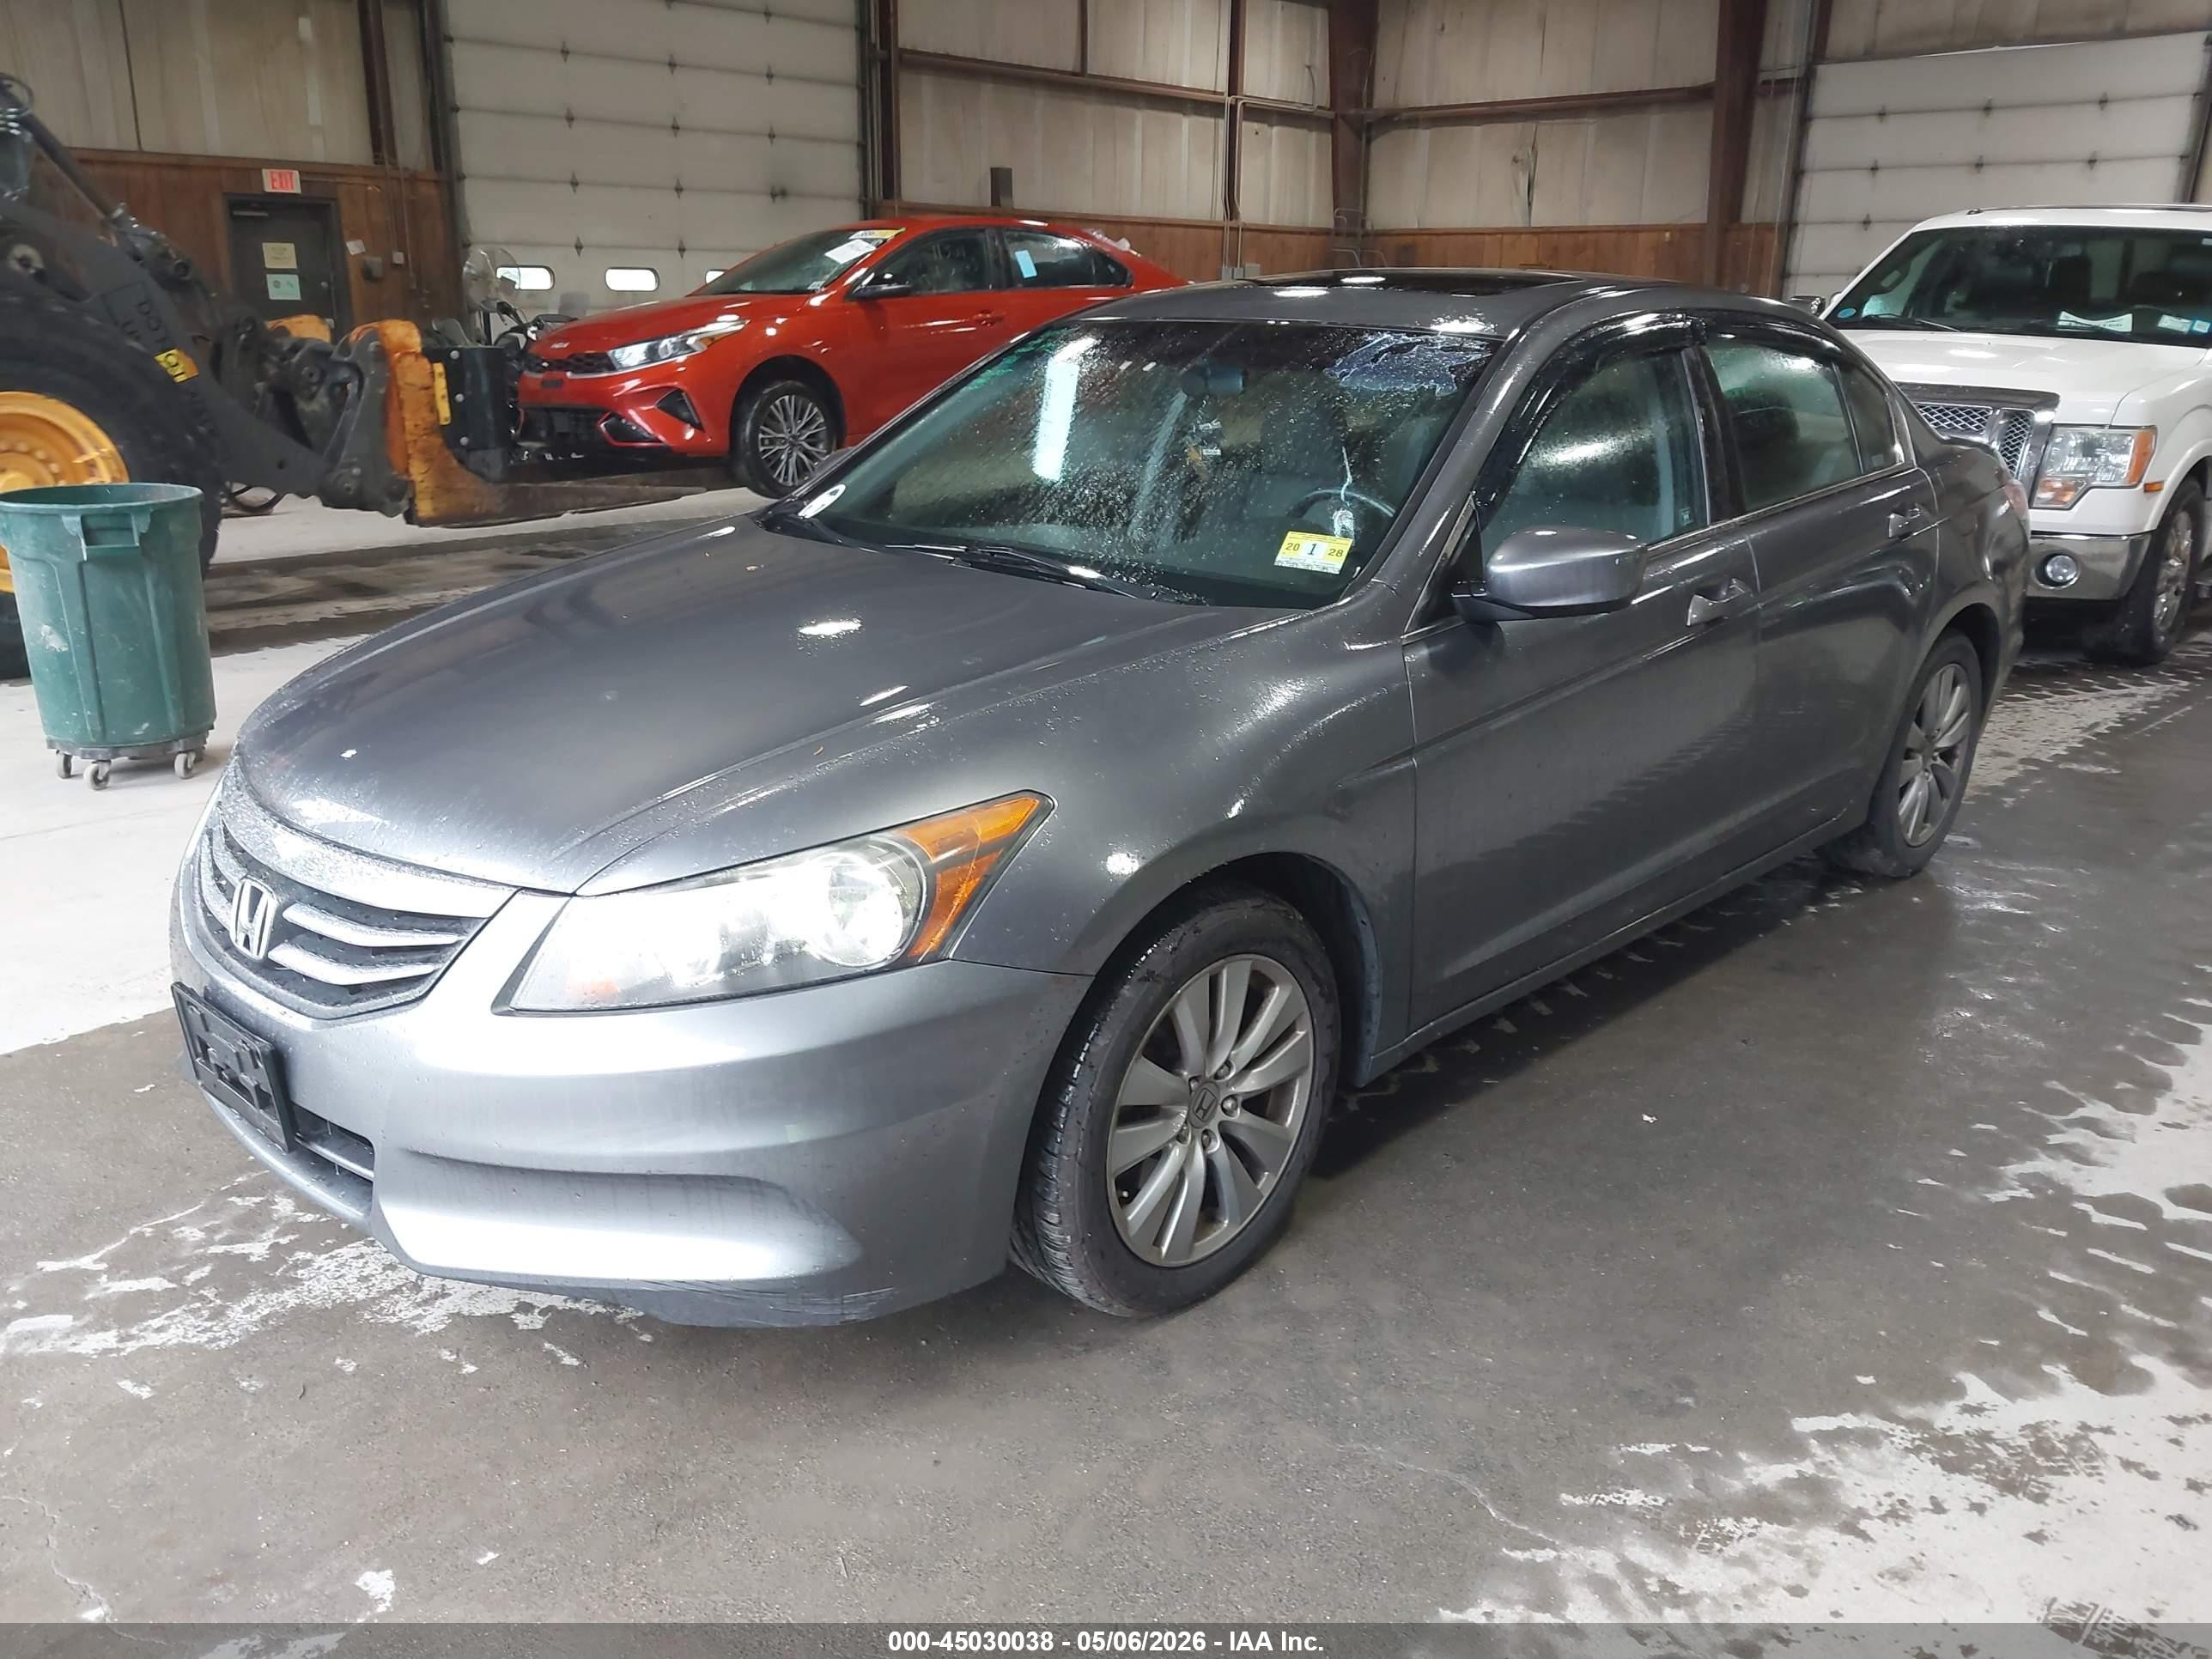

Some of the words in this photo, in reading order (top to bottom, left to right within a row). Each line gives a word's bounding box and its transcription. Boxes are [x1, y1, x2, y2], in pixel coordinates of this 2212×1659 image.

[270, 171, 295, 191] EXIT
[1285, 543, 1300, 551] 20
[1307, 543, 1317, 556] 1
[1328, 548, 1344, 557] 28
